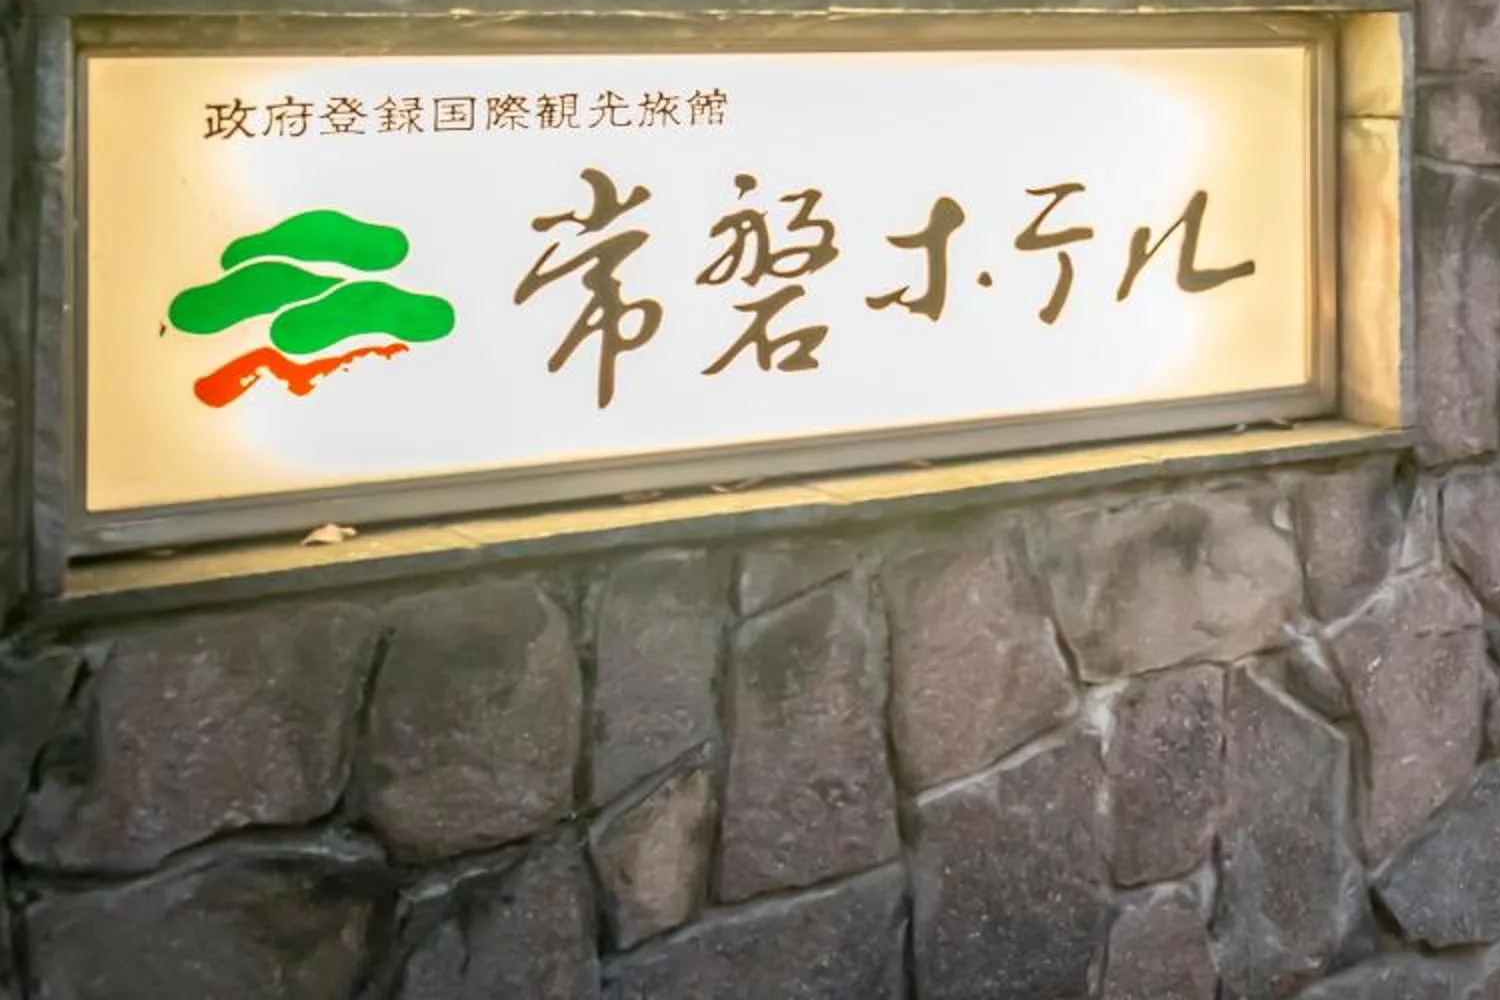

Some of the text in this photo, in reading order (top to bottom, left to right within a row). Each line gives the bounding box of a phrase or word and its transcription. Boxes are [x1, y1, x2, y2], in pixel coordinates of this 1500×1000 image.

[203, 88, 728, 139] 政府登録国際観光旅館
[514, 168, 1256, 409] 常磐ホテル
